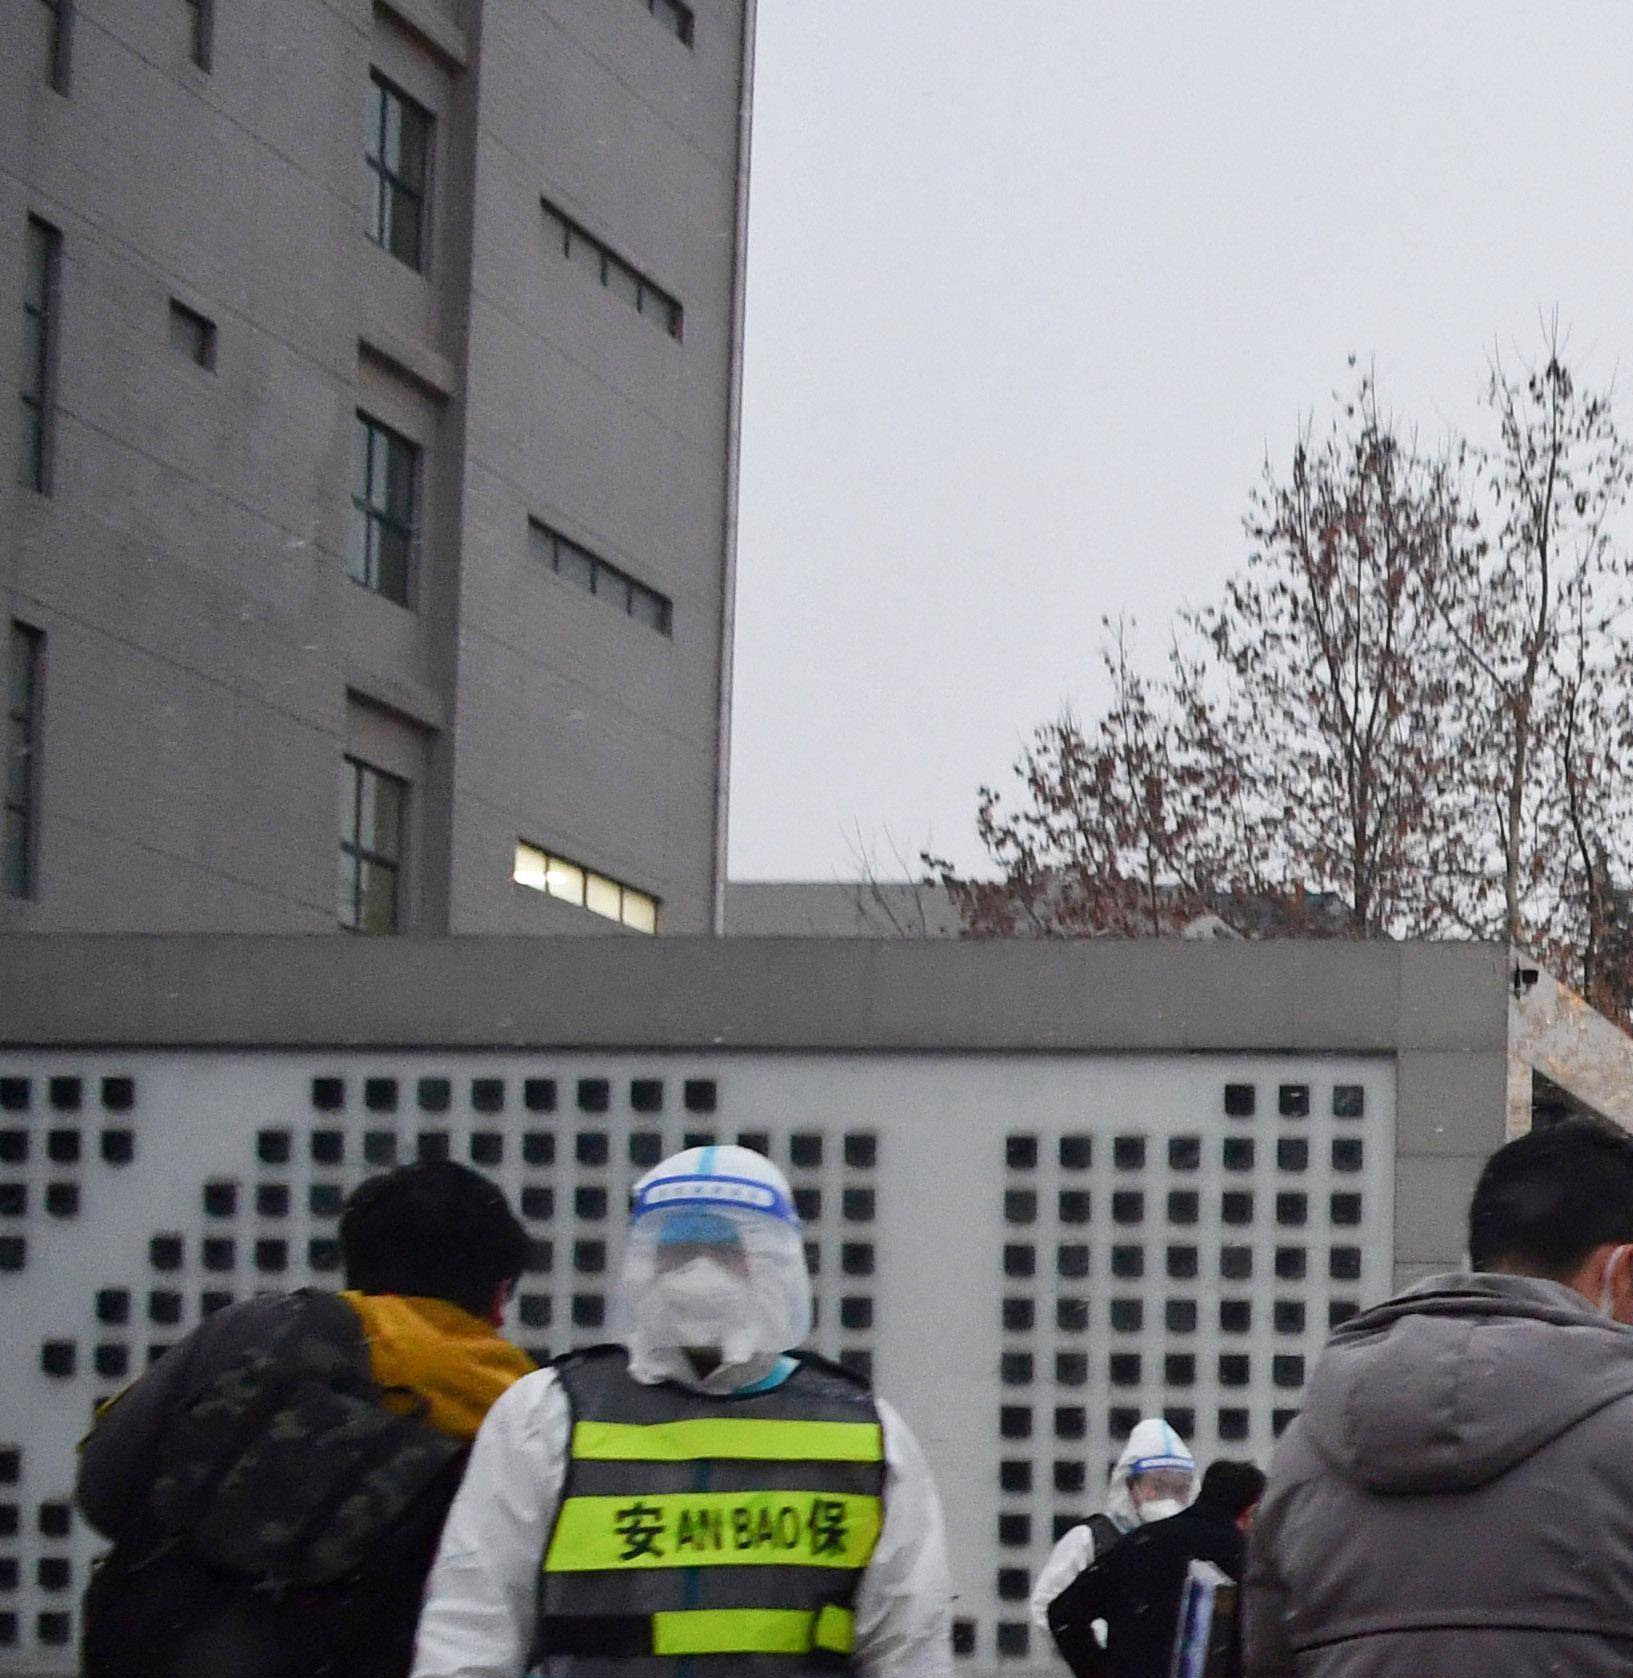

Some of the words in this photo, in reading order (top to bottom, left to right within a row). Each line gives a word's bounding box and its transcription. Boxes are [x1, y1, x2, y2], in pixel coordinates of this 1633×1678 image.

[614, 1502, 665, 1560] 安
[676, 1508, 724, 1551] AN
[729, 1505, 799, 1551] BAO
[808, 1498, 848, 1556] 保
